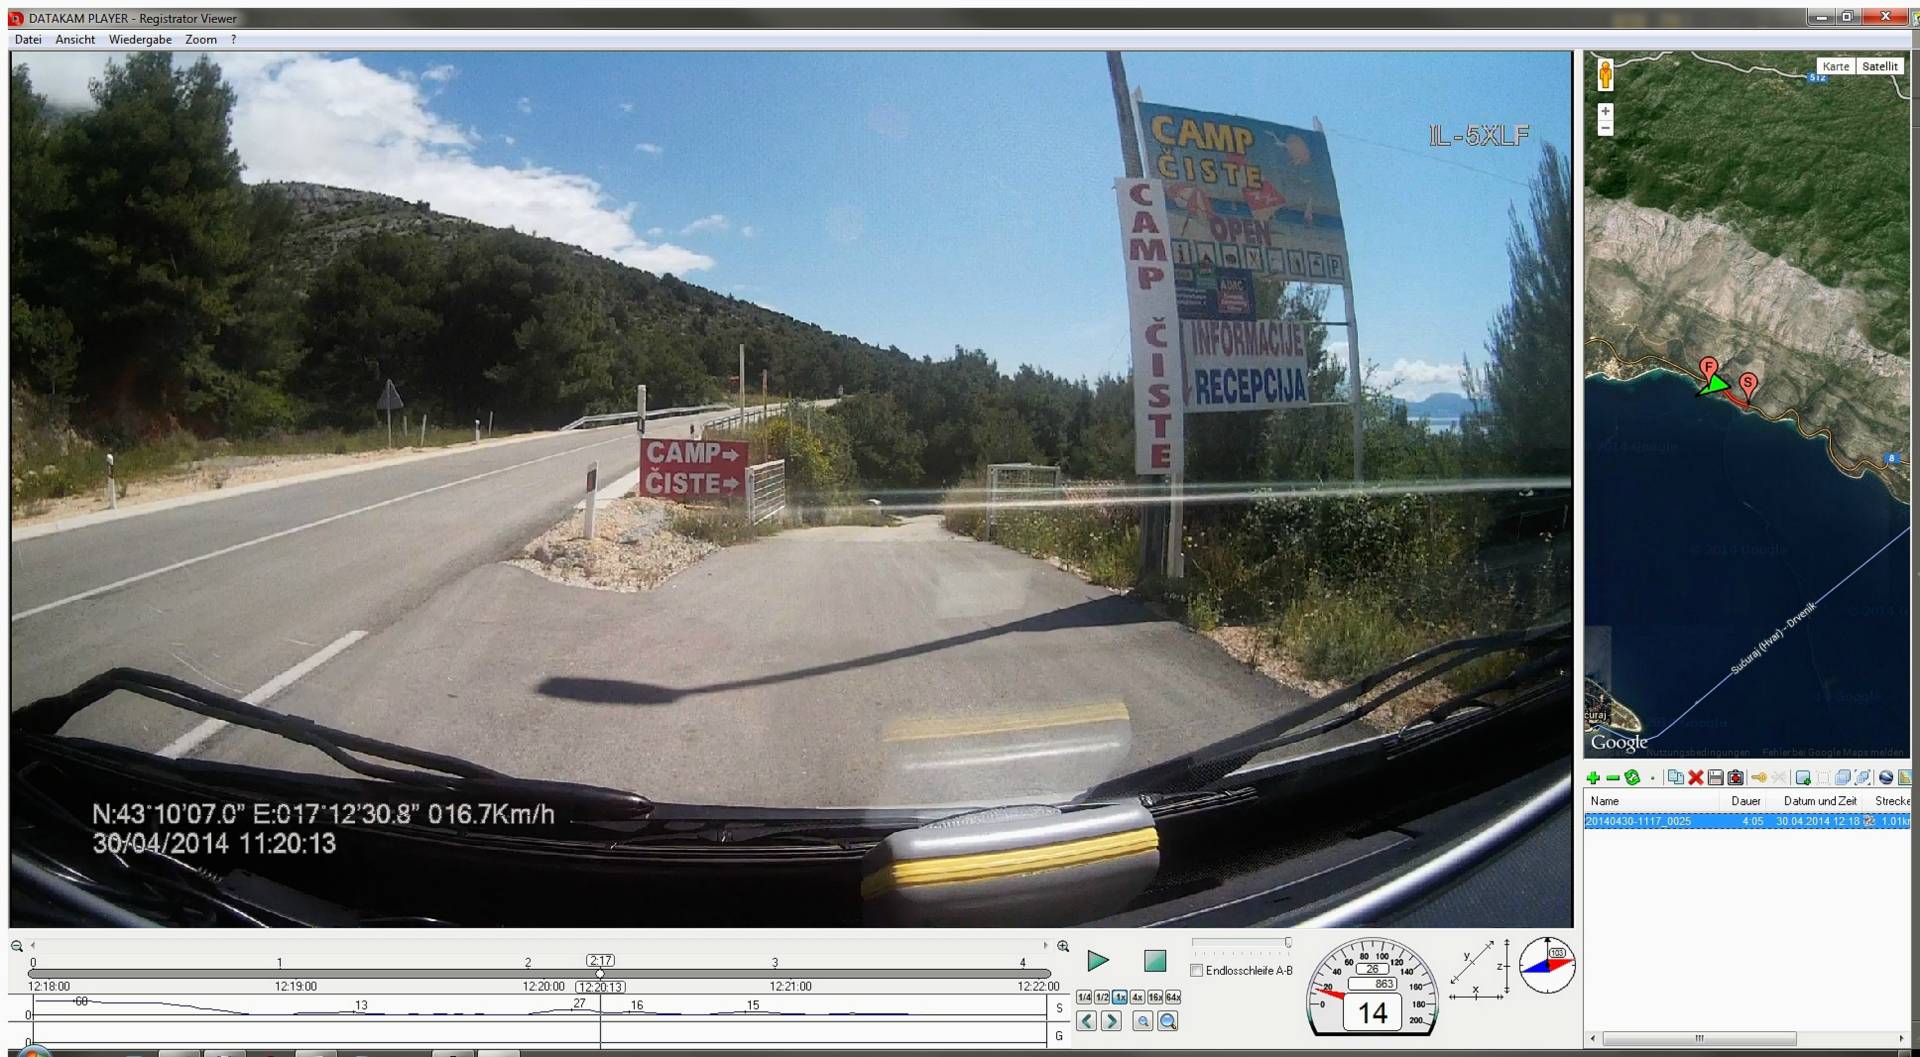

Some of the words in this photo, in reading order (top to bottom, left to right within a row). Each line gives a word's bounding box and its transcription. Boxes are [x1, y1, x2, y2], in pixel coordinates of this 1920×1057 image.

[29, 13, 85, 24] DATAKAM
[88, 13, 129, 24] PLAYER
[139, 13, 198, 26] Registrator
[200, 13, 238, 24] Viewer
[15, 34, 42, 45] Datei
[55, 34, 96, 45] Ansicht
[109, 34, 173, 48] Wiedergabe
[185, 34, 218, 45] Zoom
[231, 34, 237, 45] ?
[1823, 62, 1850, 71] Karte
[1862, 61, 1899, 71] Satellit
[1152, 115, 1255, 155] CAMP
[1157, 148, 1264, 190] ČISTE
[1129, 183, 1168, 290] CAMP
[1208, 217, 1273, 246] OPEN
[1192, 322, 1304, 357] INFORMACIJE
[1705, 361, 1713, 373] F
[1194, 367, 1307, 405] RECEPCIJA
[1743, 376, 1752, 388] S
[1144, 316, 1173, 469] ČISTE
[646, 441, 721, 464] CAMP
[1889, 454, 1895, 462] 8
[645, 467, 721, 494] ČISTE
[1758, 628, 1784, 653] (Hvar)
[1786, 602, 1817, 628] Drvenik
[1591, 734, 1649, 754] Google
[1591, 796, 1620, 806] Name
[1731, 796, 1761, 806] Dauer
[1784, 796, 1816, 806] Datum
[1818, 796, 1837, 806] und
[1838, 796, 1858, 806] Zeit
[1875, 796, 1911, 806] Strecke
[1585, 816, 1692, 828] 20140430-1117_0025
[1742, 816, 1765, 826] 4:05
[1776, 816, 1831, 826] 30.04.2014
[1834, 816, 1860, 826] 12:18
[1463, 952, 1471, 961] y
[1551, 949, 1564, 957] 103
[30, 957, 37, 968] 0
[276, 957, 282, 968] 1
[525, 957, 532, 968] 2
[590, 955, 612, 966] 2:17
[771, 957, 779, 968] 3
[1020, 957, 1026, 968] 4
[1344, 958, 1355, 966] 60
[1206, 966, 1274, 976] Endlosschleife
[1276, 966, 1293, 976] A-B
[1366, 964, 1379, 974] 26
[1401, 968, 1414, 976] 140
[28, 981, 71, 992] 12:18:00
[275, 981, 318, 992] 12:19:00
[523, 981, 566, 992] 12:20:00
[580, 982, 622, 993] 12:20:13
[770, 981, 812, 992] 12:21:00
[1018, 981, 1060, 992] 12:22:00
[1375, 979, 1394, 988] 863
[1409, 983, 1423, 991] 160
[1078, 993, 1092, 1001] 1/4
[1096, 993, 1110, 1001] 1/2
[1116, 993, 1126, 1001] 1x
[1132, 993, 1143, 1001] 4x
[1149, 993, 1163, 1001] 16x
[1166, 993, 1181, 1001] 64x
[355, 1000, 368, 1010] 13
[573, 998, 586, 1008] 27
[631, 1000, 644, 1010] 16
[747, 1000, 760, 1010] 15
[1056, 1003, 1063, 1013] S
[25, 1010, 32, 1020] 0
[1359, 1002, 1388, 1024] 14
[1055, 1030, 1063, 1041] G
